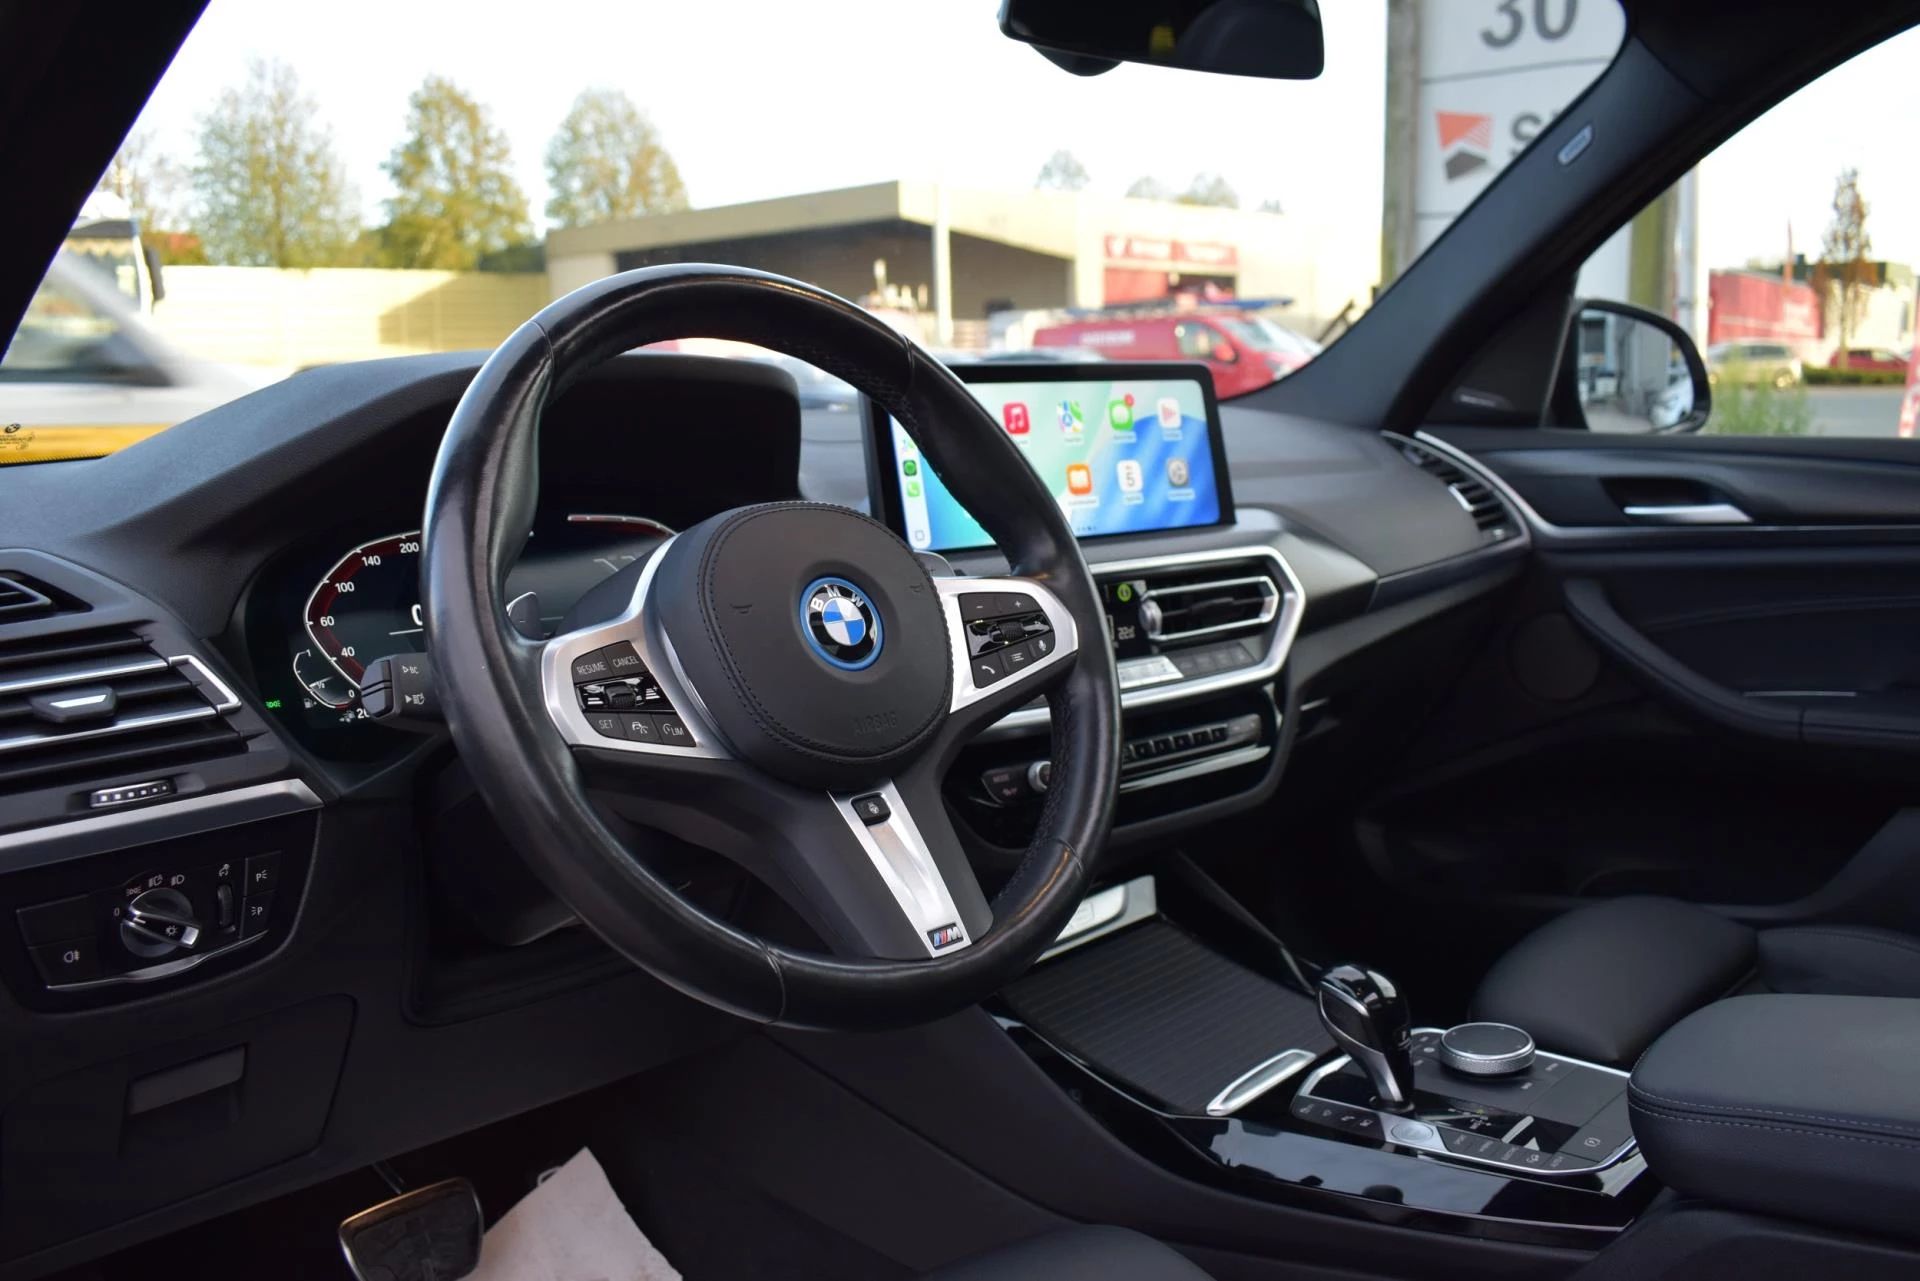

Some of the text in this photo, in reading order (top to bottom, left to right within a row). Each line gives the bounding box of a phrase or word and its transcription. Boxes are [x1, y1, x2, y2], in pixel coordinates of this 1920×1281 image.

[1480, 0, 1578, 49] 30
[399, 542, 420, 553] 200
[361, 555, 382, 567] 140
[334, 581, 355, 593] 100
[810, 585, 865, 611] BMW
[320, 615, 335, 627] 60
[341, 646, 355, 658] 40
[576, 661, 607, 675] RESUME
[612, 655, 640, 669] CANCEL
[598, 719, 614, 730] SET
[671, 727, 685, 736] LIM
